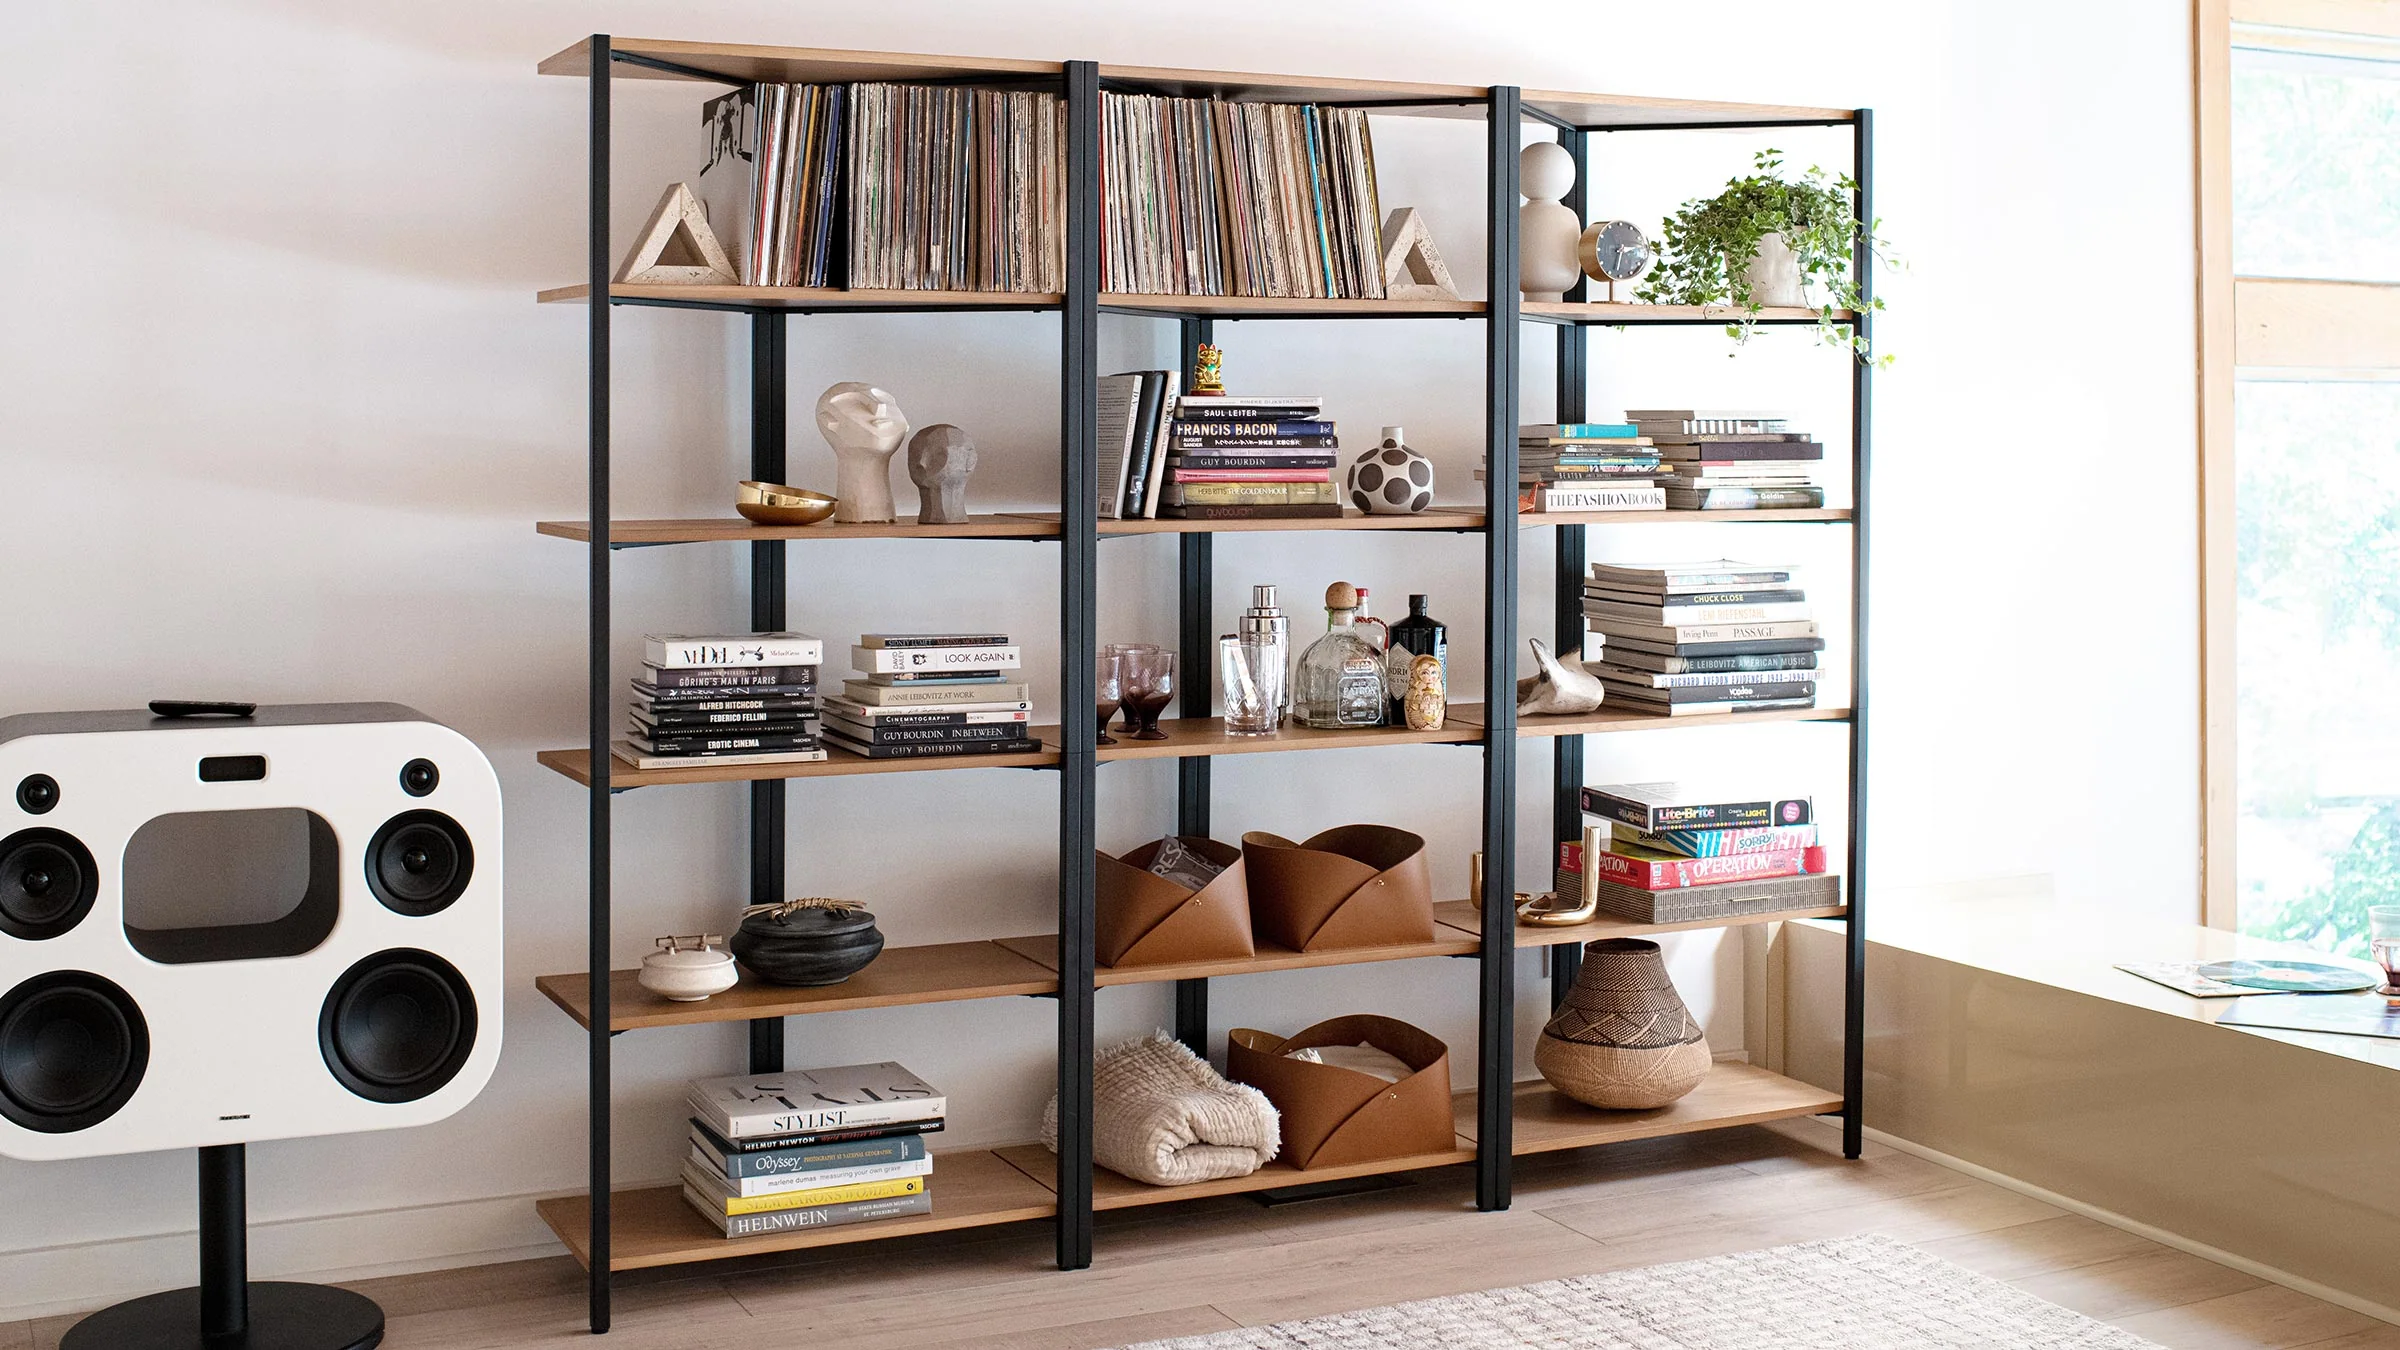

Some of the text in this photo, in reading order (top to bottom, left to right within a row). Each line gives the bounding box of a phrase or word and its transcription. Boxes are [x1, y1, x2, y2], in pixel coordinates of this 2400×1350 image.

[1204, 409, 1257, 417] SAUL LEITER
[1176, 423, 1231, 436] FRANCIS
[1235, 423, 1277, 436] BACON
[1200, 458, 1266, 466] GUY BOURDIN
[1240, 487, 1270, 495] GOLDEN
[1760, 491, 1785, 500] Goldin
[1693, 594, 1744, 603] CHUCK CLOSE
[1683, 629, 1719, 639] Irving Penn
[1733, 627, 1775, 638] PASSAGE
[944, 652, 1005, 663] LOOK AGAIN
[1696, 659, 1736, 669] LEIBOVITZ
[1738, 658, 1778, 668] AMERICAN
[1781, 656, 1806, 667] MUSIC
[679, 676, 777, 688] GÖRING'S MAN IN PARIS
[802, 668, 810, 684] Yale
[1670, 676, 1700, 687] RICHARD
[1703, 675, 1729, 686] AVEDON
[1731, 673, 1763, 685] EVIDENCE
[887, 693, 909, 701] ANNIE
[909, 692, 943, 701] LEIBOVITZ
[953, 691, 975, 699] WORK
[699, 700, 764, 711] ALFRED HITCHCOCK
[709, 712, 767, 723] FEDERICO FELLINI
[883, 727, 1003, 741] GUY BOURDIN IN BETWEEN
[707, 738, 760, 750] EROTIC CINEMA
[891, 744, 963, 755] GUY BOURDIN
[1745, 808, 1767, 817] LIGHT
[1739, 832, 1776, 849] SORRY!
[1692, 854, 1773, 878] OPERATION
[773, 1110, 847, 1132] STYLIST
[745, 1136, 815, 1151] HELMUT NEWTON
[755, 1155, 802, 1174] Odyssey
[768, 1178, 794, 1187] marlene
[795, 1175, 817, 1184] dumas
[820, 1170, 854, 1180] measuring
[854, 1168, 868, 1178] your
[884, 1165, 901, 1174] grave
[785, 1191, 842, 1206] AARONS
[737, 1209, 828, 1234] HELNWEIN
